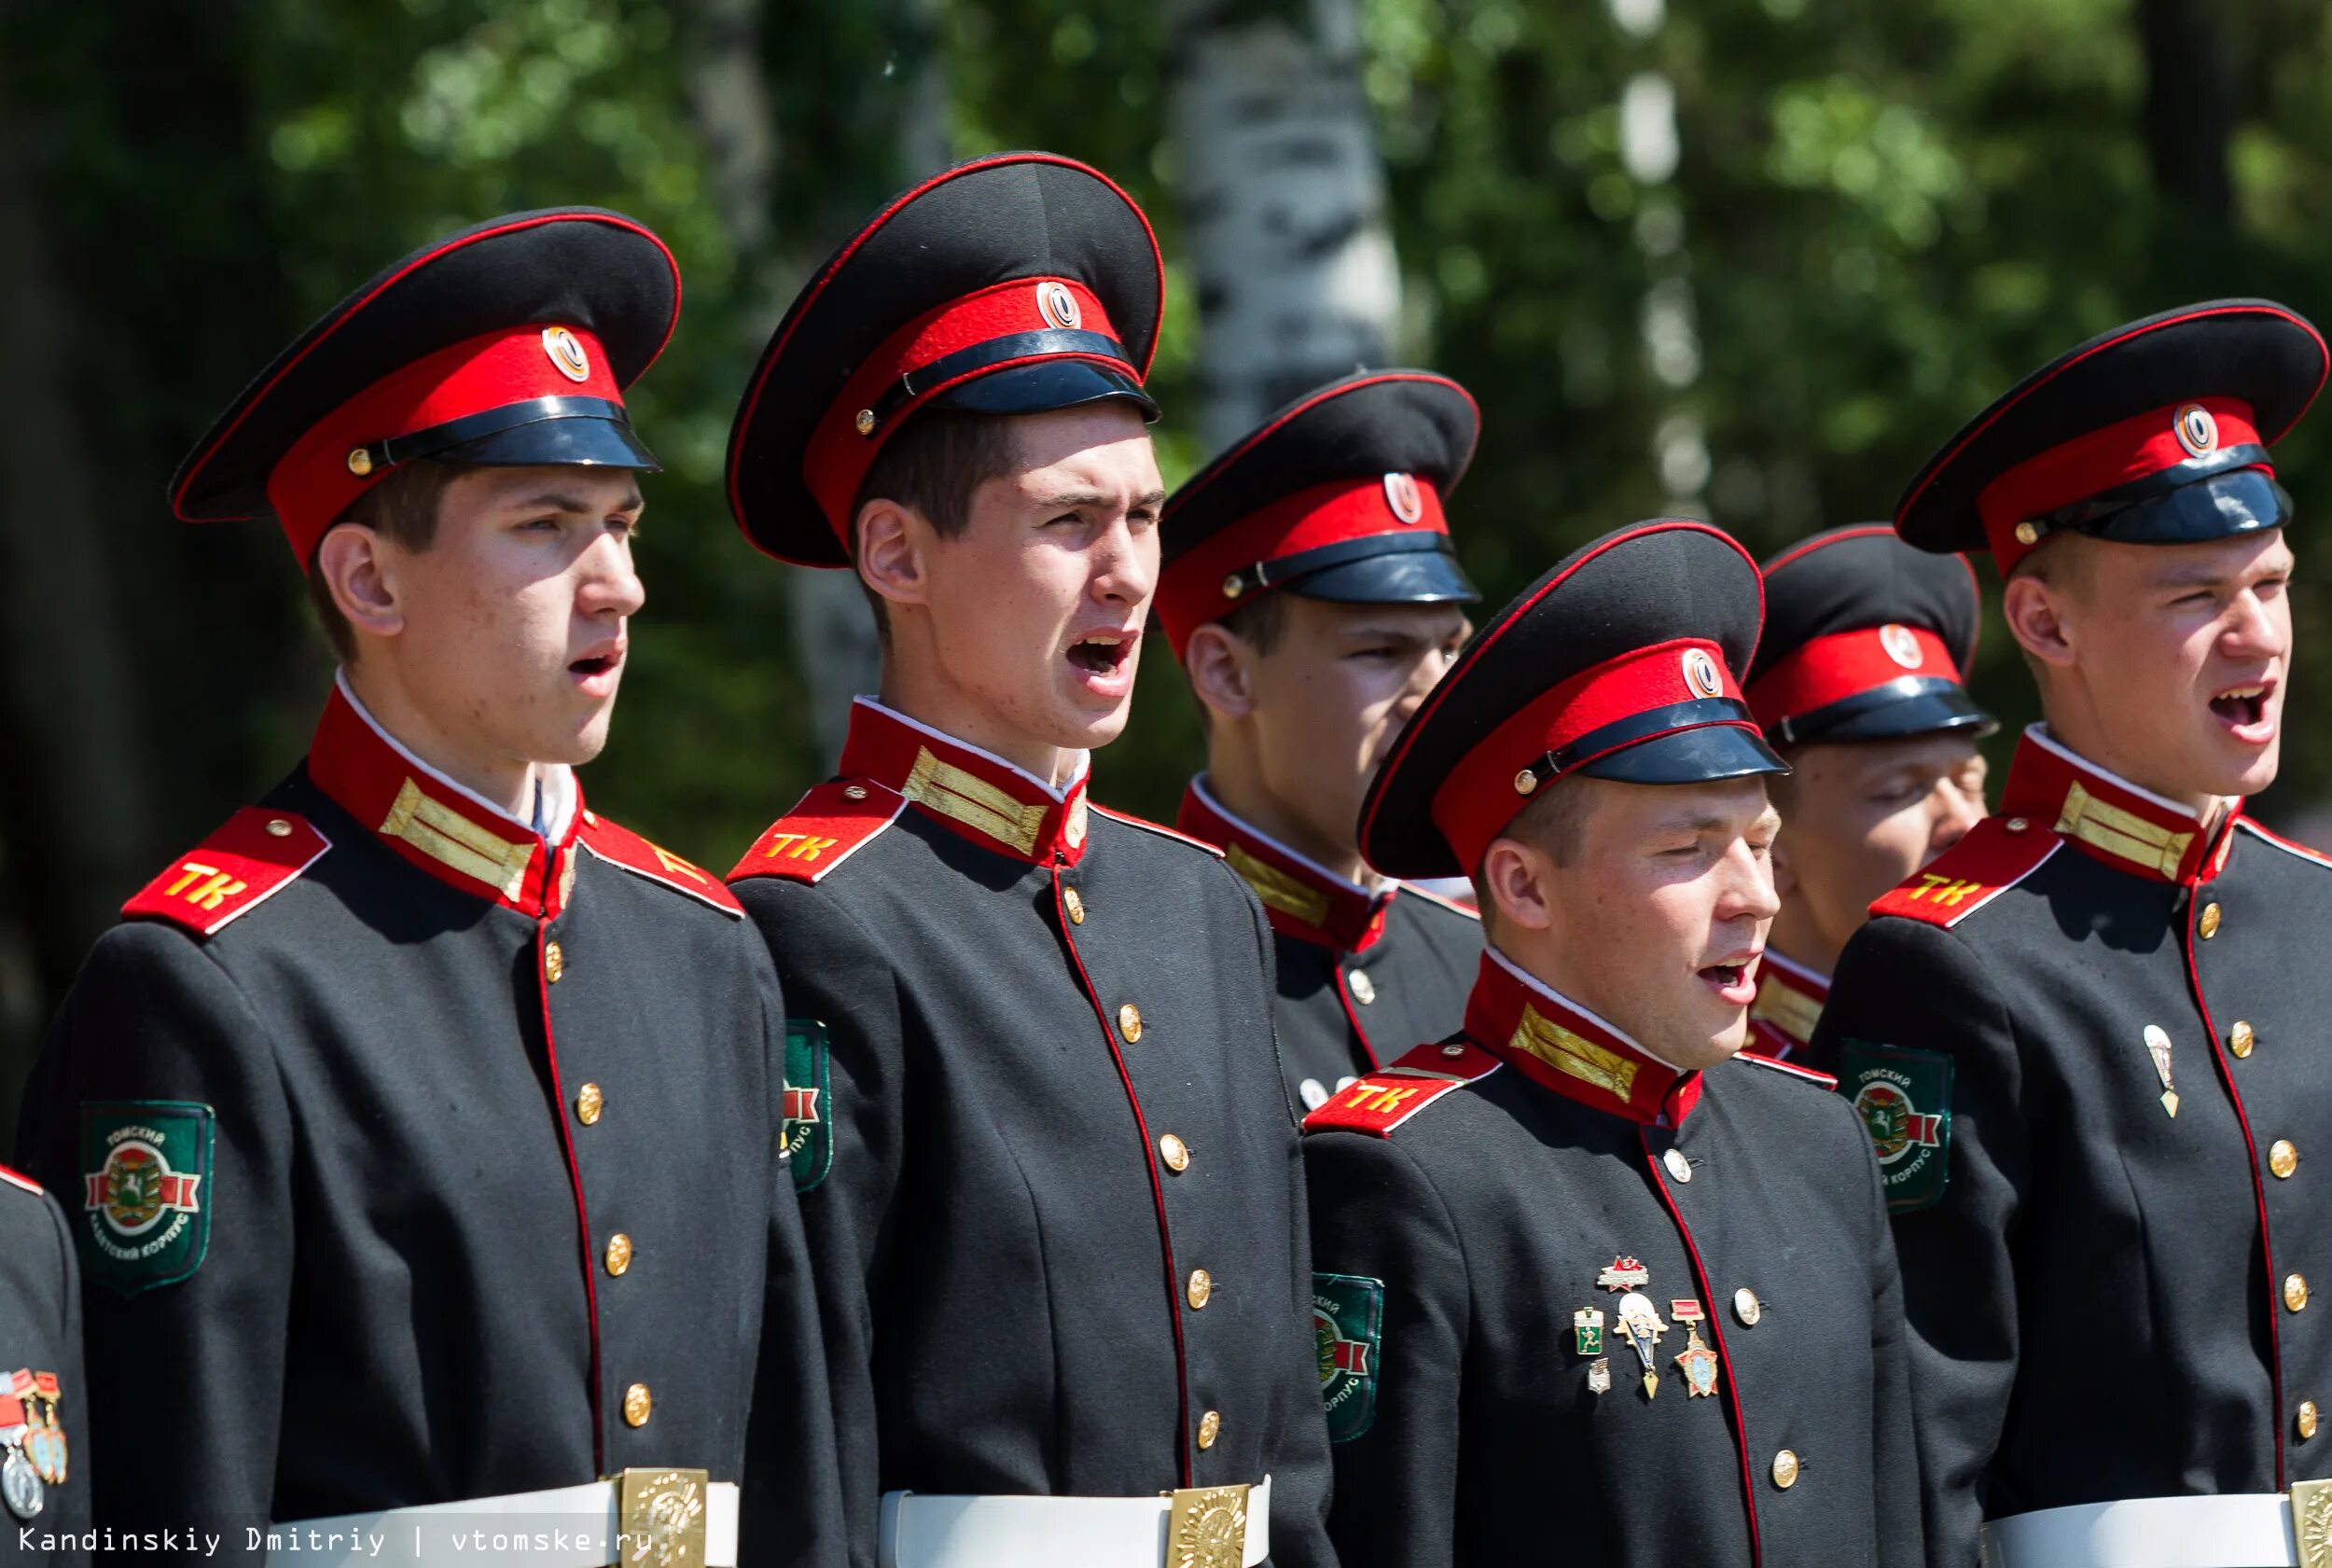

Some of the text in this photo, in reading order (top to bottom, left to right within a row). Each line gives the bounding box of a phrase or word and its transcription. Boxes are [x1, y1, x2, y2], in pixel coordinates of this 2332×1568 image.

[764, 832, 839, 862] ТК
[163, 862, 248, 910] ТК
[1909, 873, 1982, 907] ТК
[1858, 1068, 1911, 1089] ТОМСКИЙ
[1344, 1084, 1419, 1114] ТК
[105, 1125, 166, 1147] ТОМСКИЙ
[789, 1125, 812, 1153] ПУС
[1890, 1148, 1932, 1186] КОРПУС
[141, 1212, 189, 1258] КОРПУС
[1323, 1376, 1360, 1412] ОРПУС
